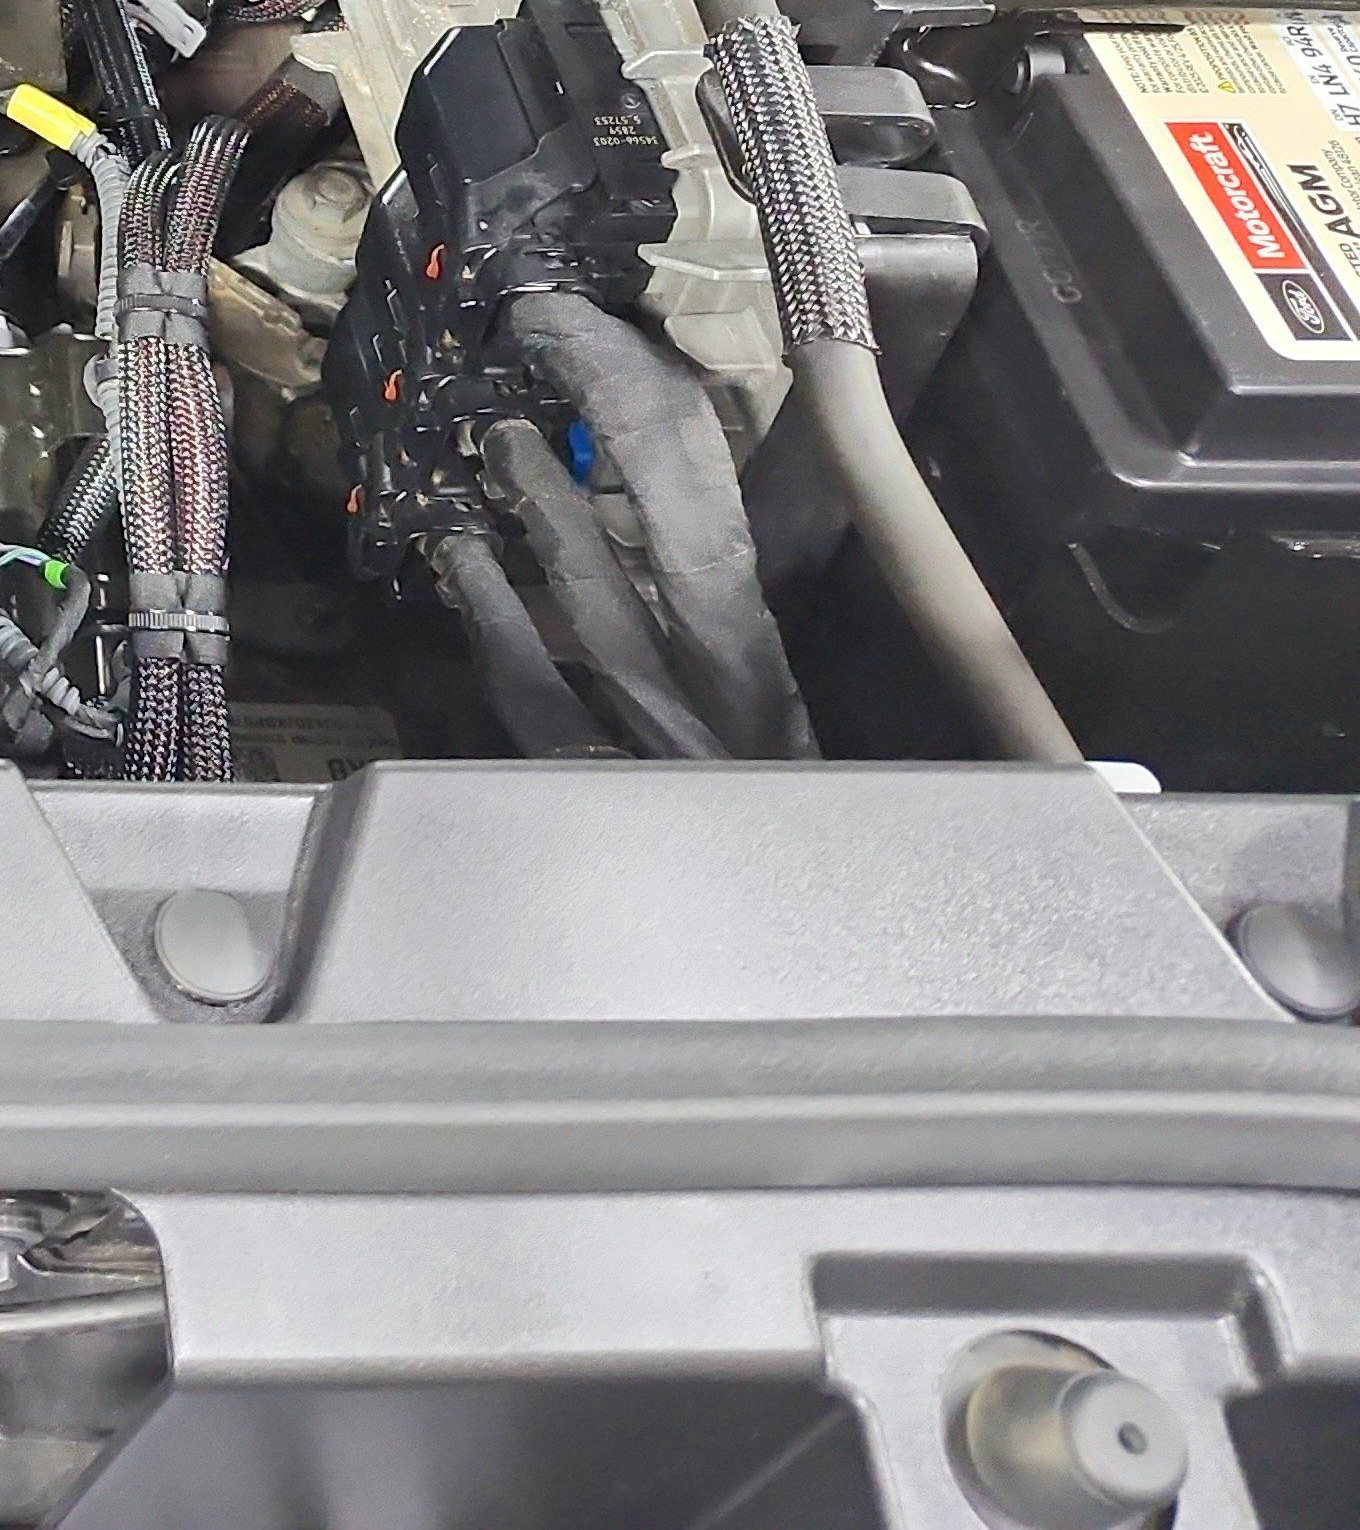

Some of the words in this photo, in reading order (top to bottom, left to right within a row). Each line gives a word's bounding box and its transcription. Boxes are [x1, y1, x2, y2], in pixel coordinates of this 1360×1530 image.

[1312, 64, 1350, 96] LN4
[1321, 149, 1353, 192] Company
[1188, 131, 1286, 259] Motorcraft
[1287, 164, 1360, 238] AGM
[1292, 288, 1318, 325] Ford
